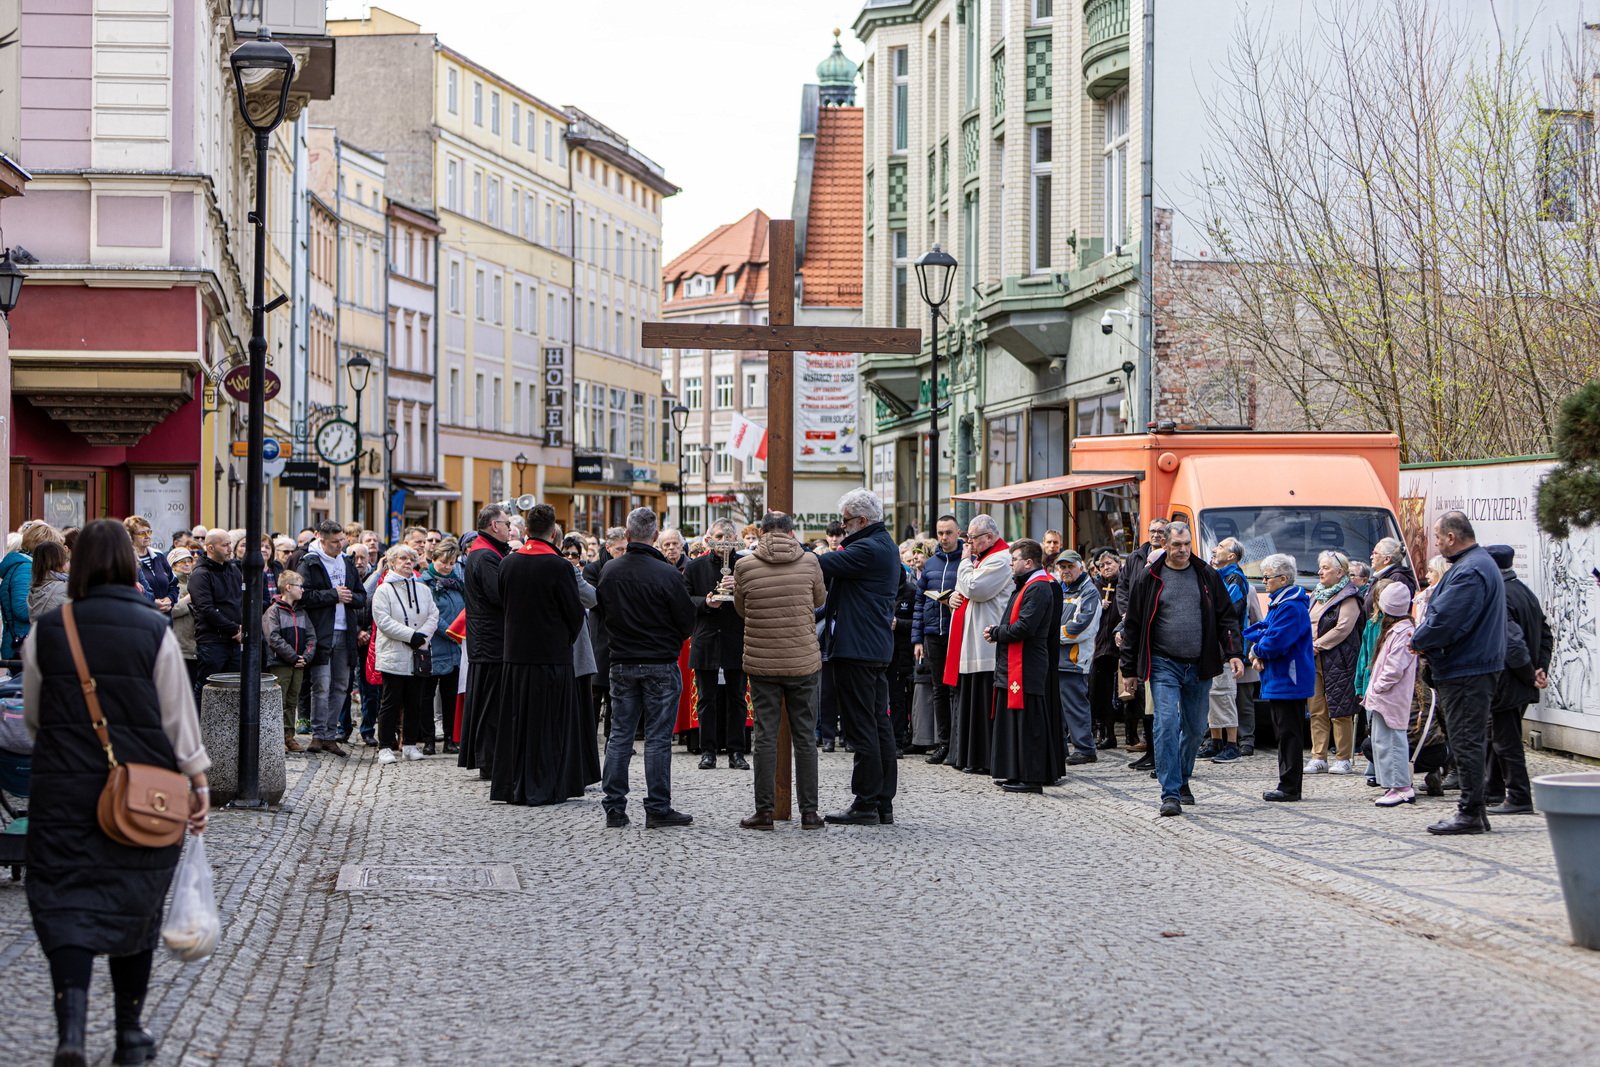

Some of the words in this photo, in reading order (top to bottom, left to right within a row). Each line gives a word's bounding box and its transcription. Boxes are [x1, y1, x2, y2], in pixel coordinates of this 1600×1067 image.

[227, 374, 276, 394] Wael
[546, 349, 562, 447] HOTEL
[578, 464, 601, 474] empik
[167, 503, 185, 511] 200
[1435, 496, 1443, 510] Jak
[1466, 496, 1528, 520] LICZYRZEPA?
